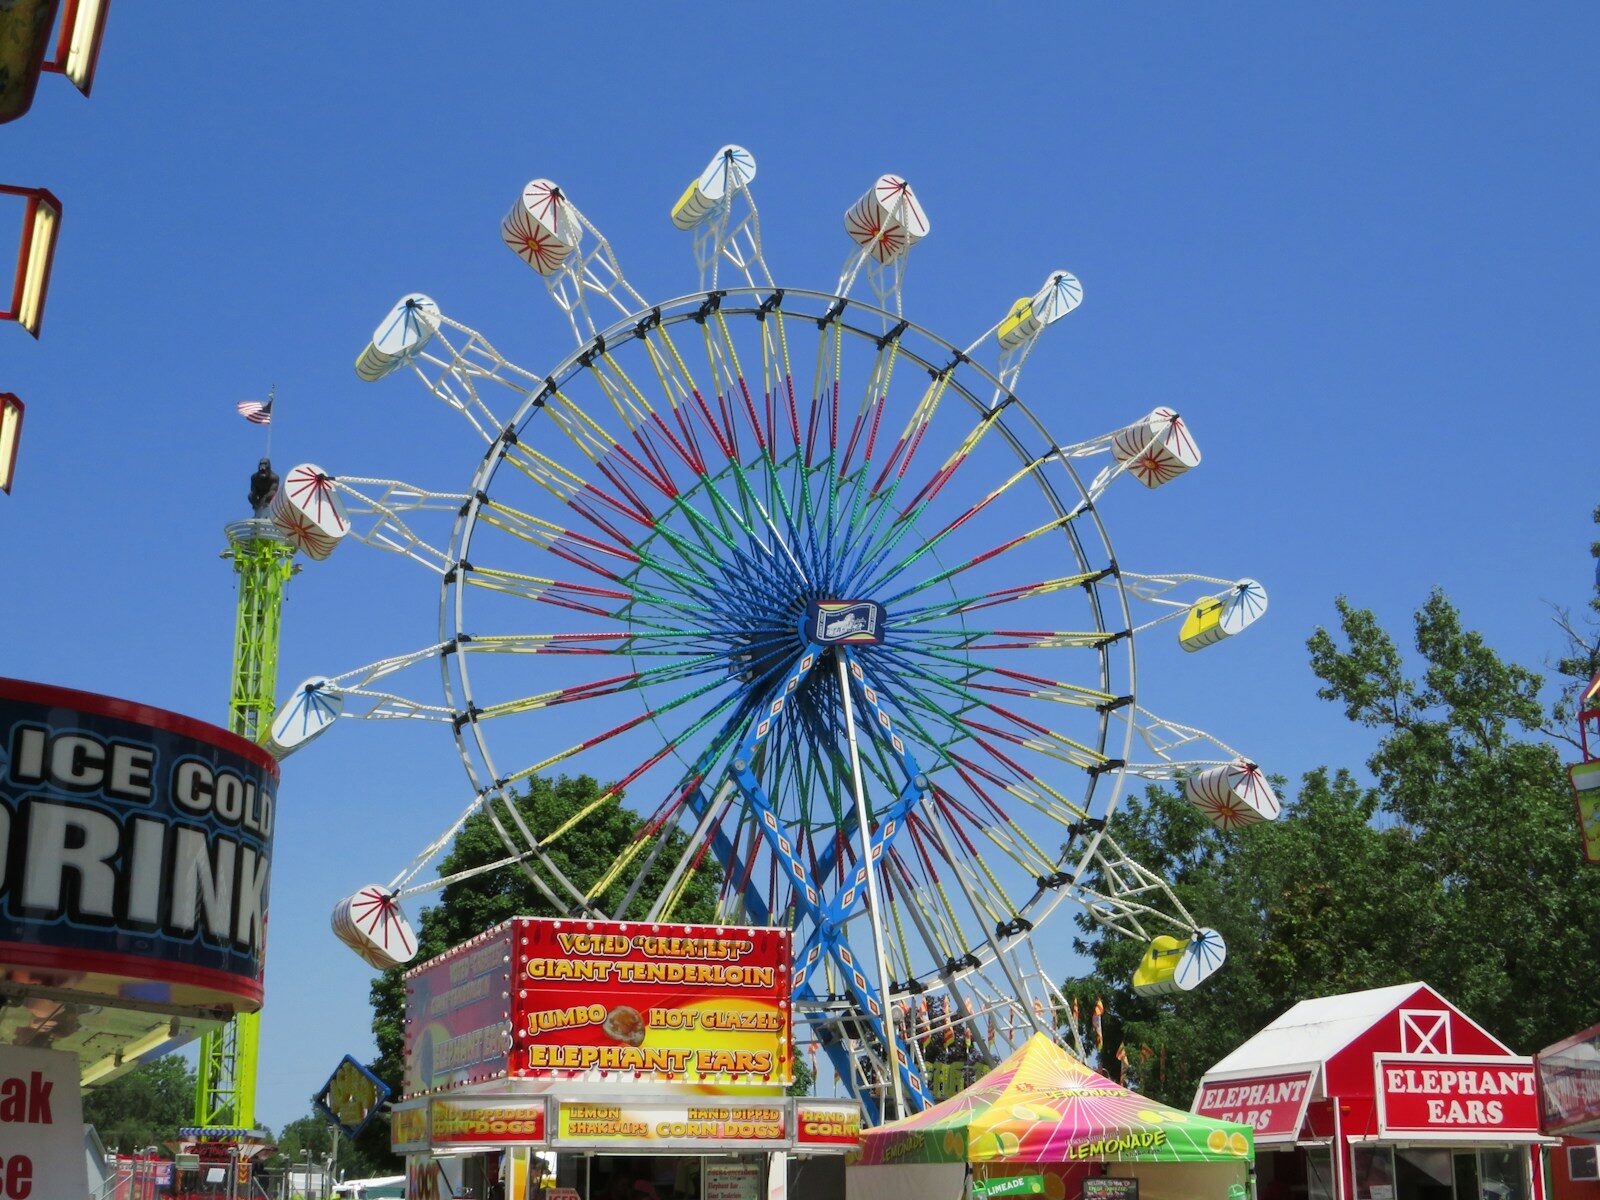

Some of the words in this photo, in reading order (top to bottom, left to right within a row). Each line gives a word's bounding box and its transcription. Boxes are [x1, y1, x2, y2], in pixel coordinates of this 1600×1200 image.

[17, 728, 154, 798] ICE
[176, 761, 273, 839] COLD
[557, 933, 630, 956] VOTED
[527, 959, 612, 980] GIANT
[615, 962, 774, 987] TENDERLOIN
[528, 1004, 607, 1035] JUMBO
[650, 1008, 698, 1029] HOT
[701, 1010, 785, 1031] GLAZED
[530, 1045, 692, 1071] ELEPHANT
[696, 1049, 772, 1073] EARS
[1386, 1069, 1536, 1095] ELEPHANT
[1044, 1089, 1129, 1099] LEMONADE
[1201, 1080, 1307, 1109] ELEPHANT
[569, 1107, 620, 1120] LEMON
[687, 1108, 730, 1121] HAND
[732, 1108, 781, 1121] DIPPED
[802, 1111, 845, 1122] HAND
[1221, 1109, 1273, 1131] EARS
[1427, 1100, 1504, 1124] EARS
[475, 1121, 537, 1135] DOGS
[656, 1122, 718, 1138] CORN
[723, 1122, 781, 1138] DOGS
[1069, 1130, 1166, 1160] LEMONADE
[987, 1177, 1025, 1196] LIMEADE
